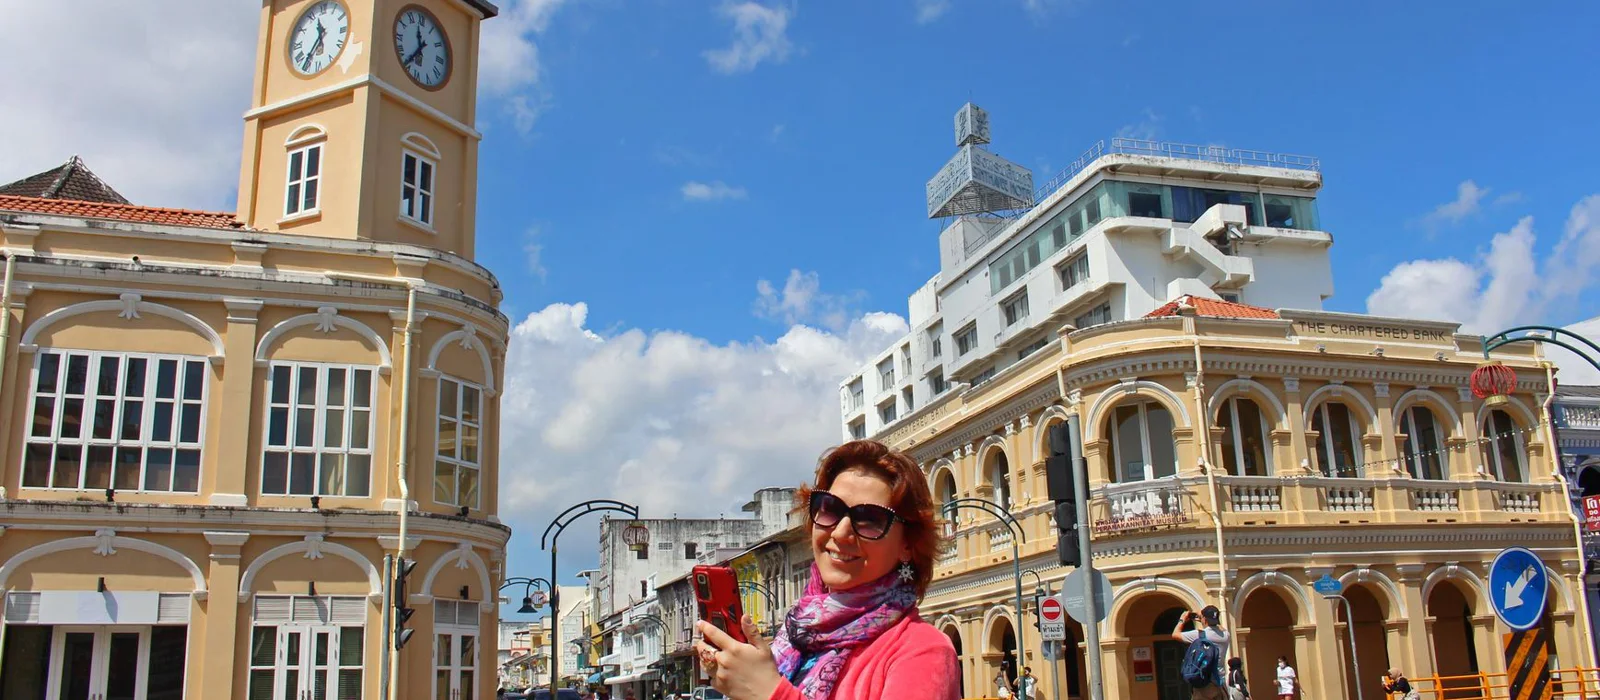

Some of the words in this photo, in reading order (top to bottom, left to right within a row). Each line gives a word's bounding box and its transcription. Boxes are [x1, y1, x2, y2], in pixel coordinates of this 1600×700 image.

[1298, 322, 1326, 334] THE
[1330, 324, 1408, 339] CHARTERED
[1414, 329, 1446, 341] BANK
[1156, 516, 1187, 525] MUSEUM
